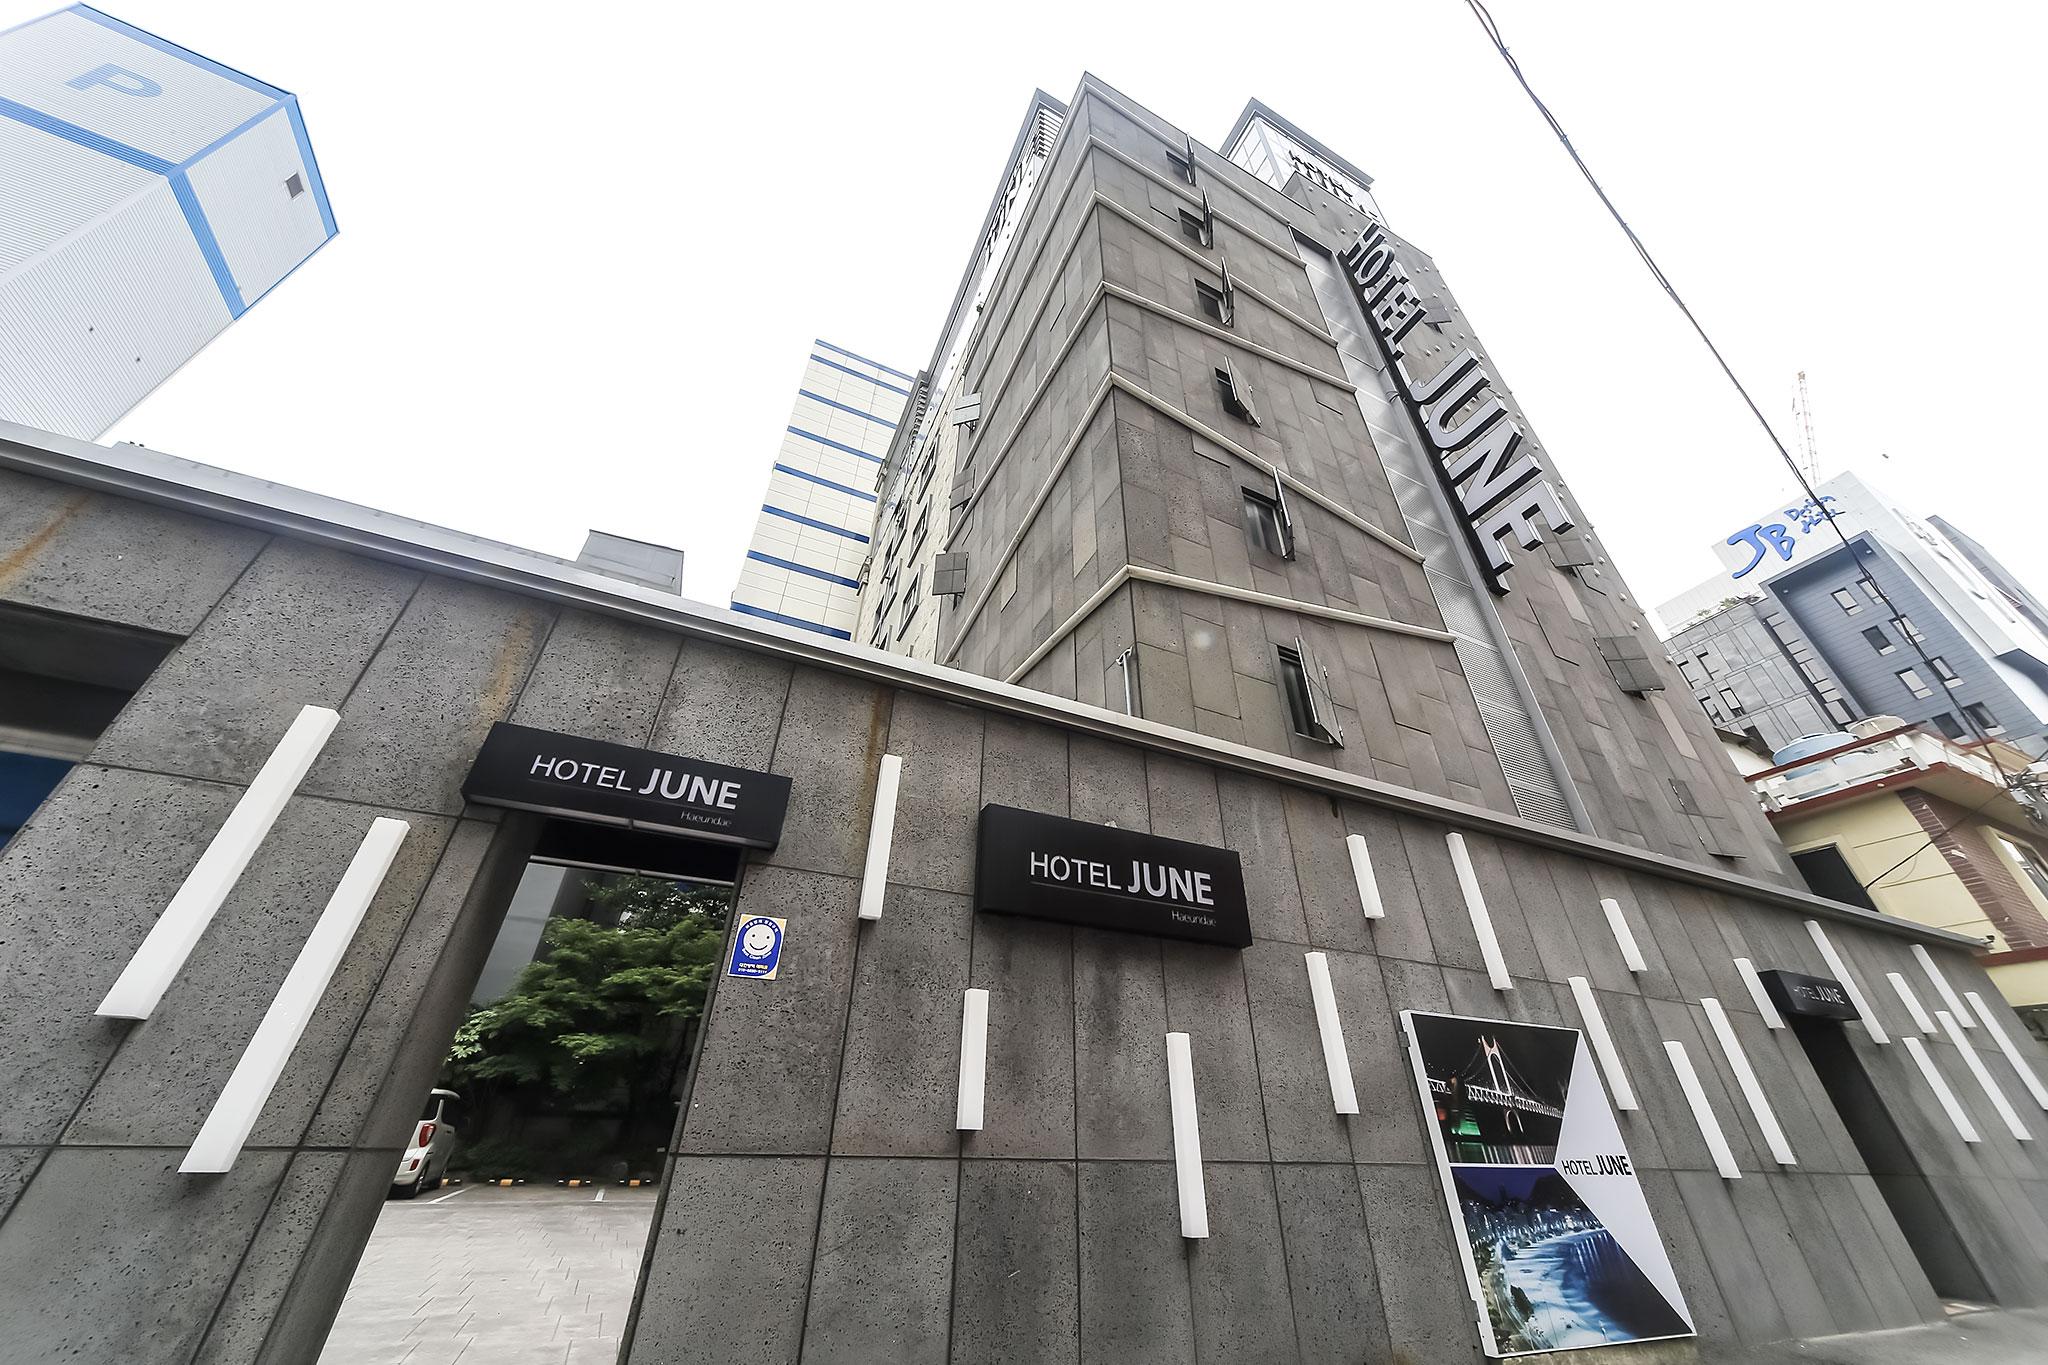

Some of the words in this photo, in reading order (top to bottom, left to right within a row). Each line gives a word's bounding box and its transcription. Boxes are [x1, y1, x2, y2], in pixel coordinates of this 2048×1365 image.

[65, 62, 164, 99] P
[1348, 220, 1430, 361] HOTEL
[1410, 347, 1576, 576] JUNE
[1726, 523, 1796, 580] JB
[529, 754, 632, 792] HOTEL
[638, 767, 742, 810] JUNE
[679, 811, 733, 828] Haeundae
[1029, 851, 1122, 890] HOTEL
[1127, 860, 1215, 906] JUNE
[1171, 910, 1217, 927] Haeundae
[1815, 985, 1845, 1005] JUNE
[1562, 1159, 1598, 1176] HOTEL
[1596, 1155, 1632, 1176] JUNE
